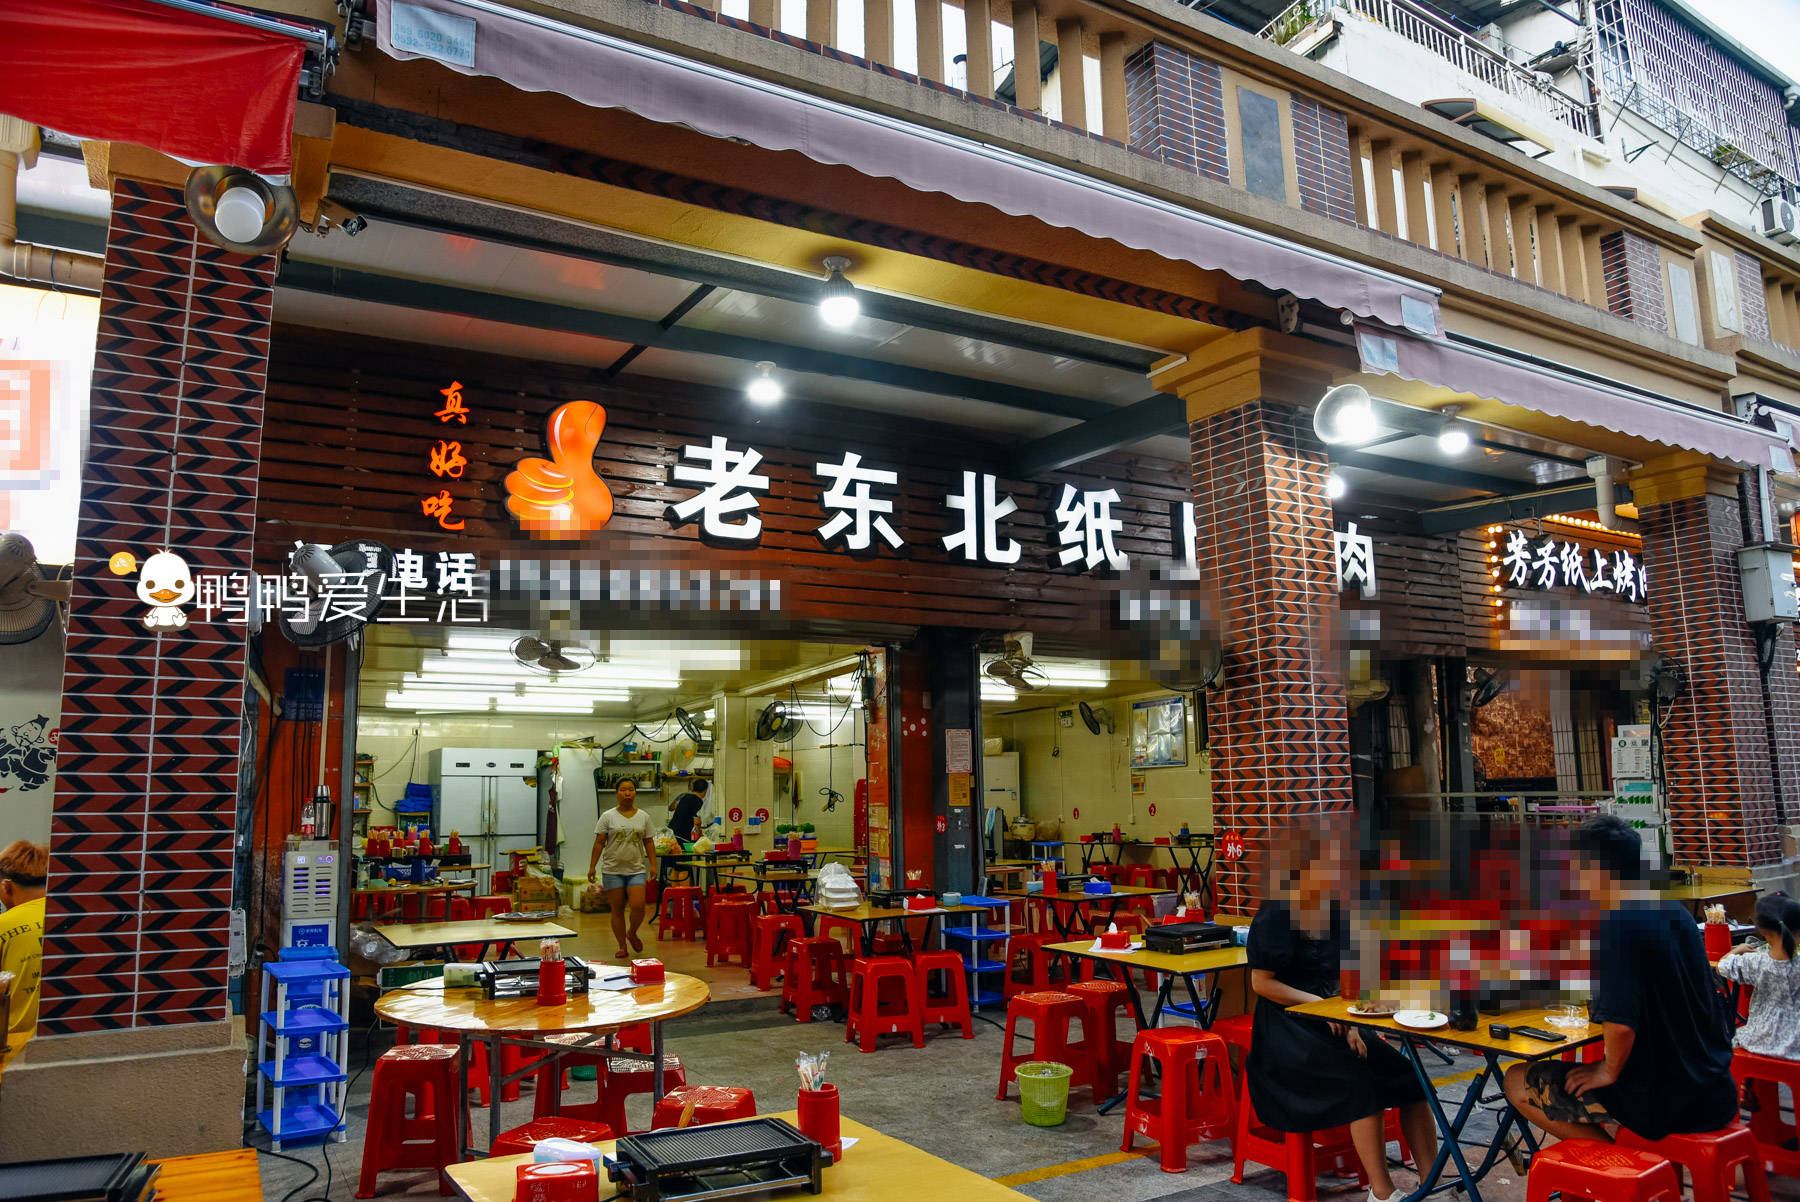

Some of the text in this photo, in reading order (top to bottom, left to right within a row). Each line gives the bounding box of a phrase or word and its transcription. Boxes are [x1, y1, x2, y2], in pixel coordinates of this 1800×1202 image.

[421, 380, 470, 530] 真好吃
[732, 812, 739, 821] 8
[759, 812, 766, 821] 5
[1227, 842, 1243, 858] 外6
[0, 924, 32, 944] THE
